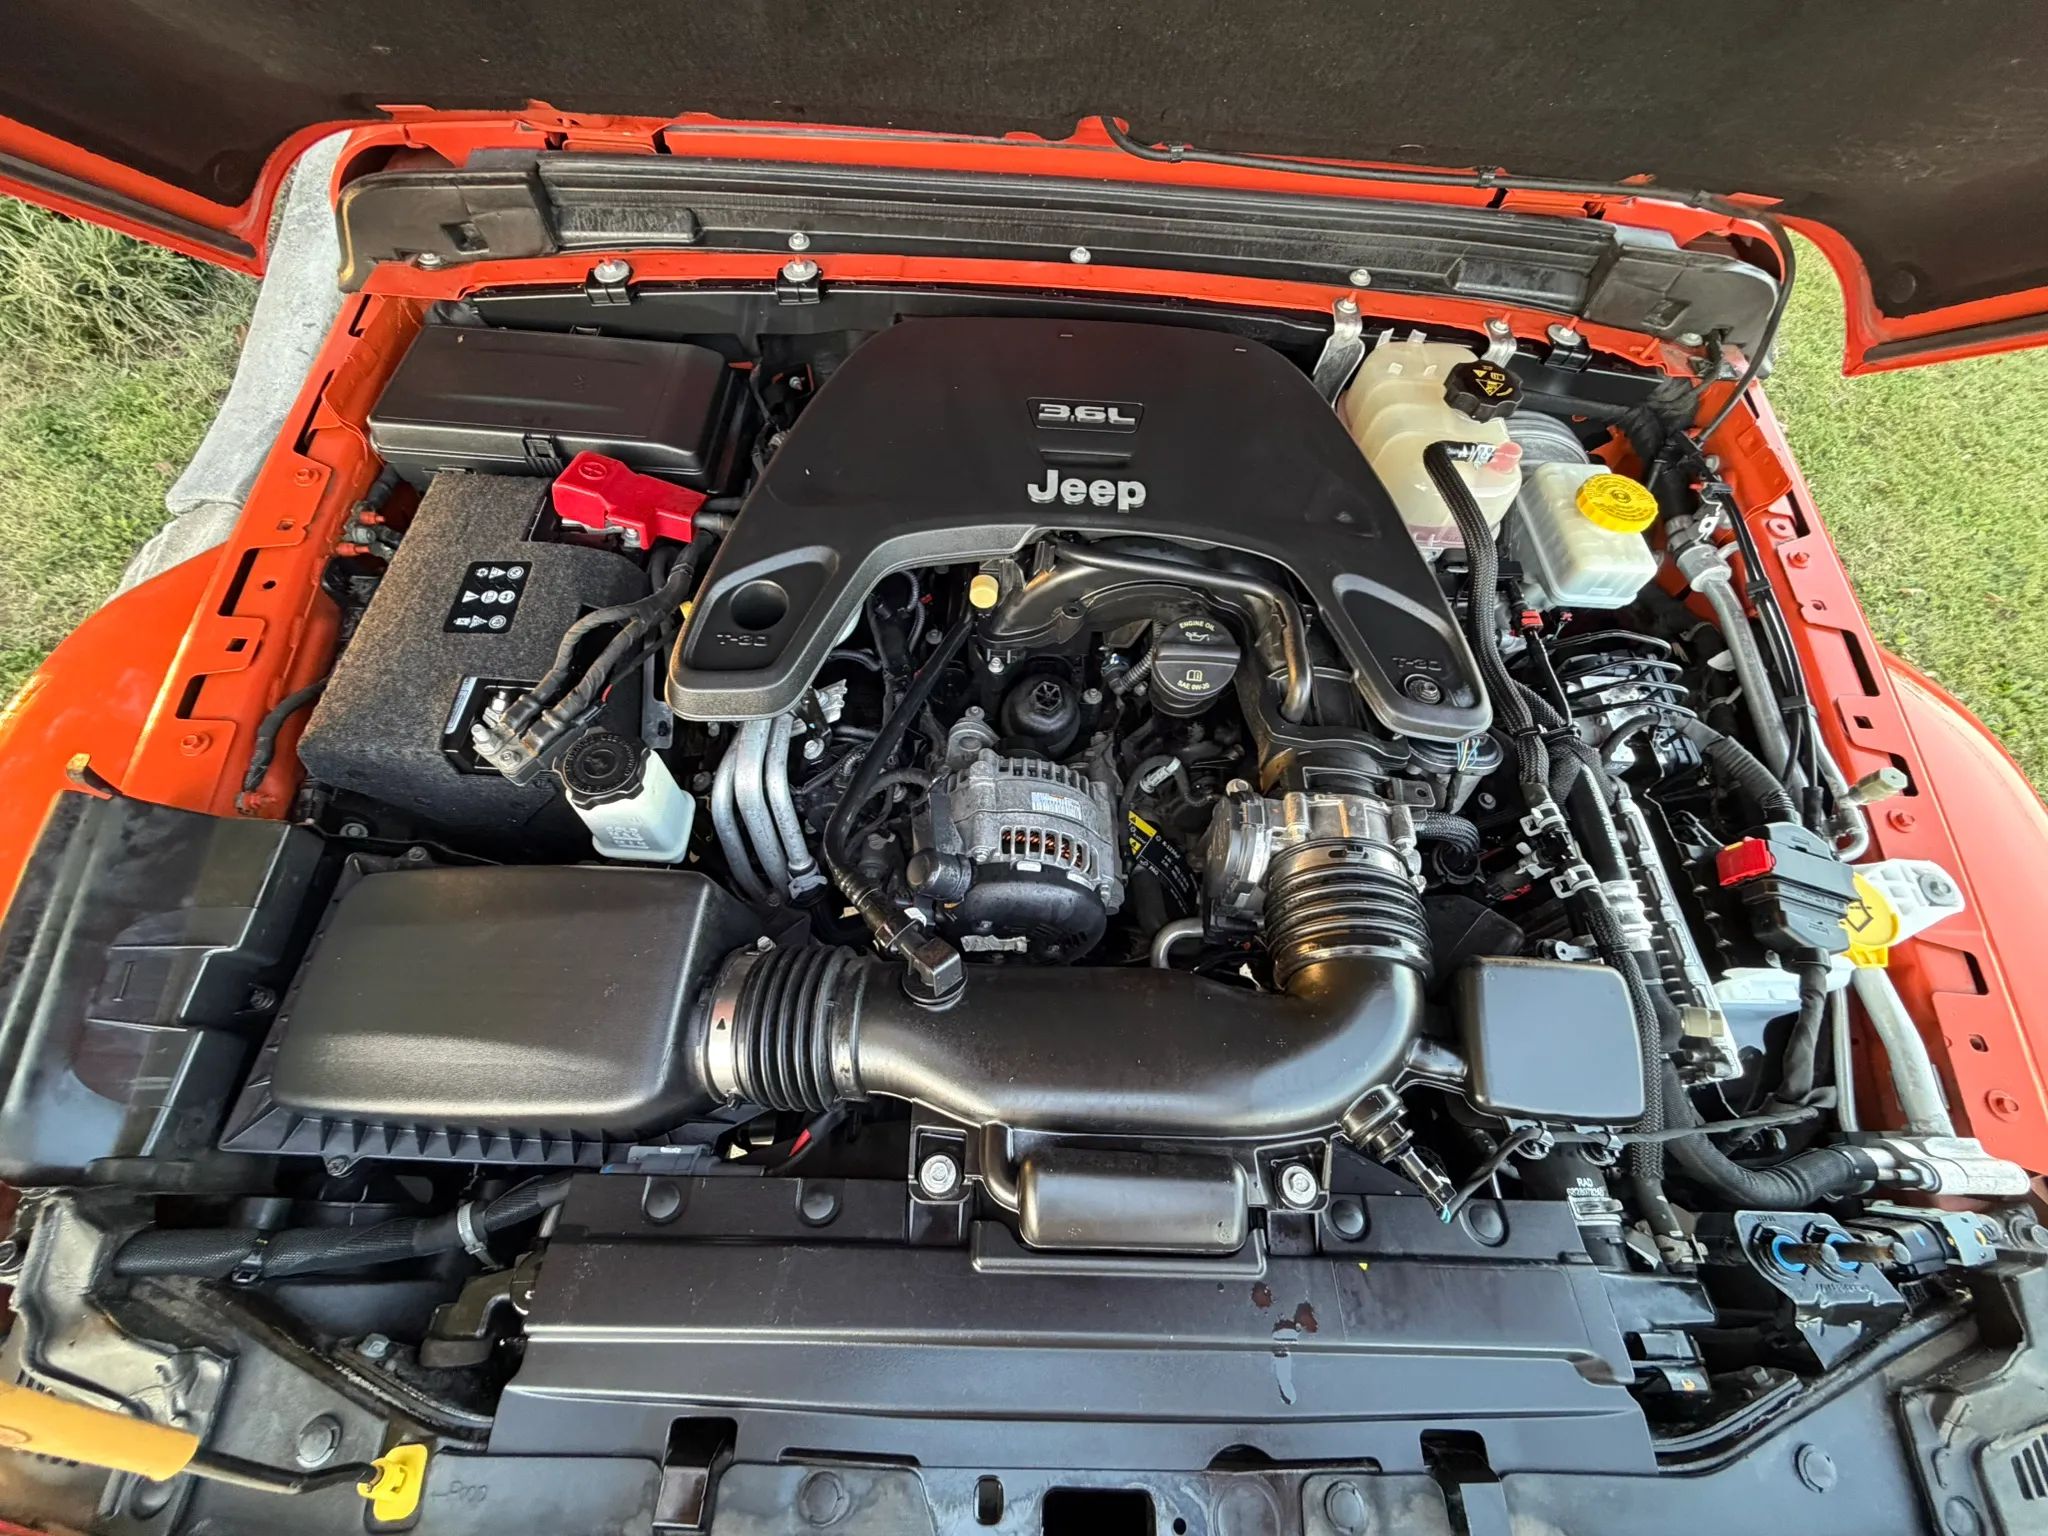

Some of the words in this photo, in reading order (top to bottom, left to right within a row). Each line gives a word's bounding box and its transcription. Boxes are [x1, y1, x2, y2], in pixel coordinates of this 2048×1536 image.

[1039, 403, 1135, 425] 3.6L
[1027, 469, 1146, 513] Jeep
[1179, 620, 1204, 629] ENGINE
[1204, 622, 1215, 631] OIL
[1177, 680, 1190, 690] SAE
[1191, 682, 1210, 690] 0W-20
[1576, 1177, 1593, 1187] RAD
